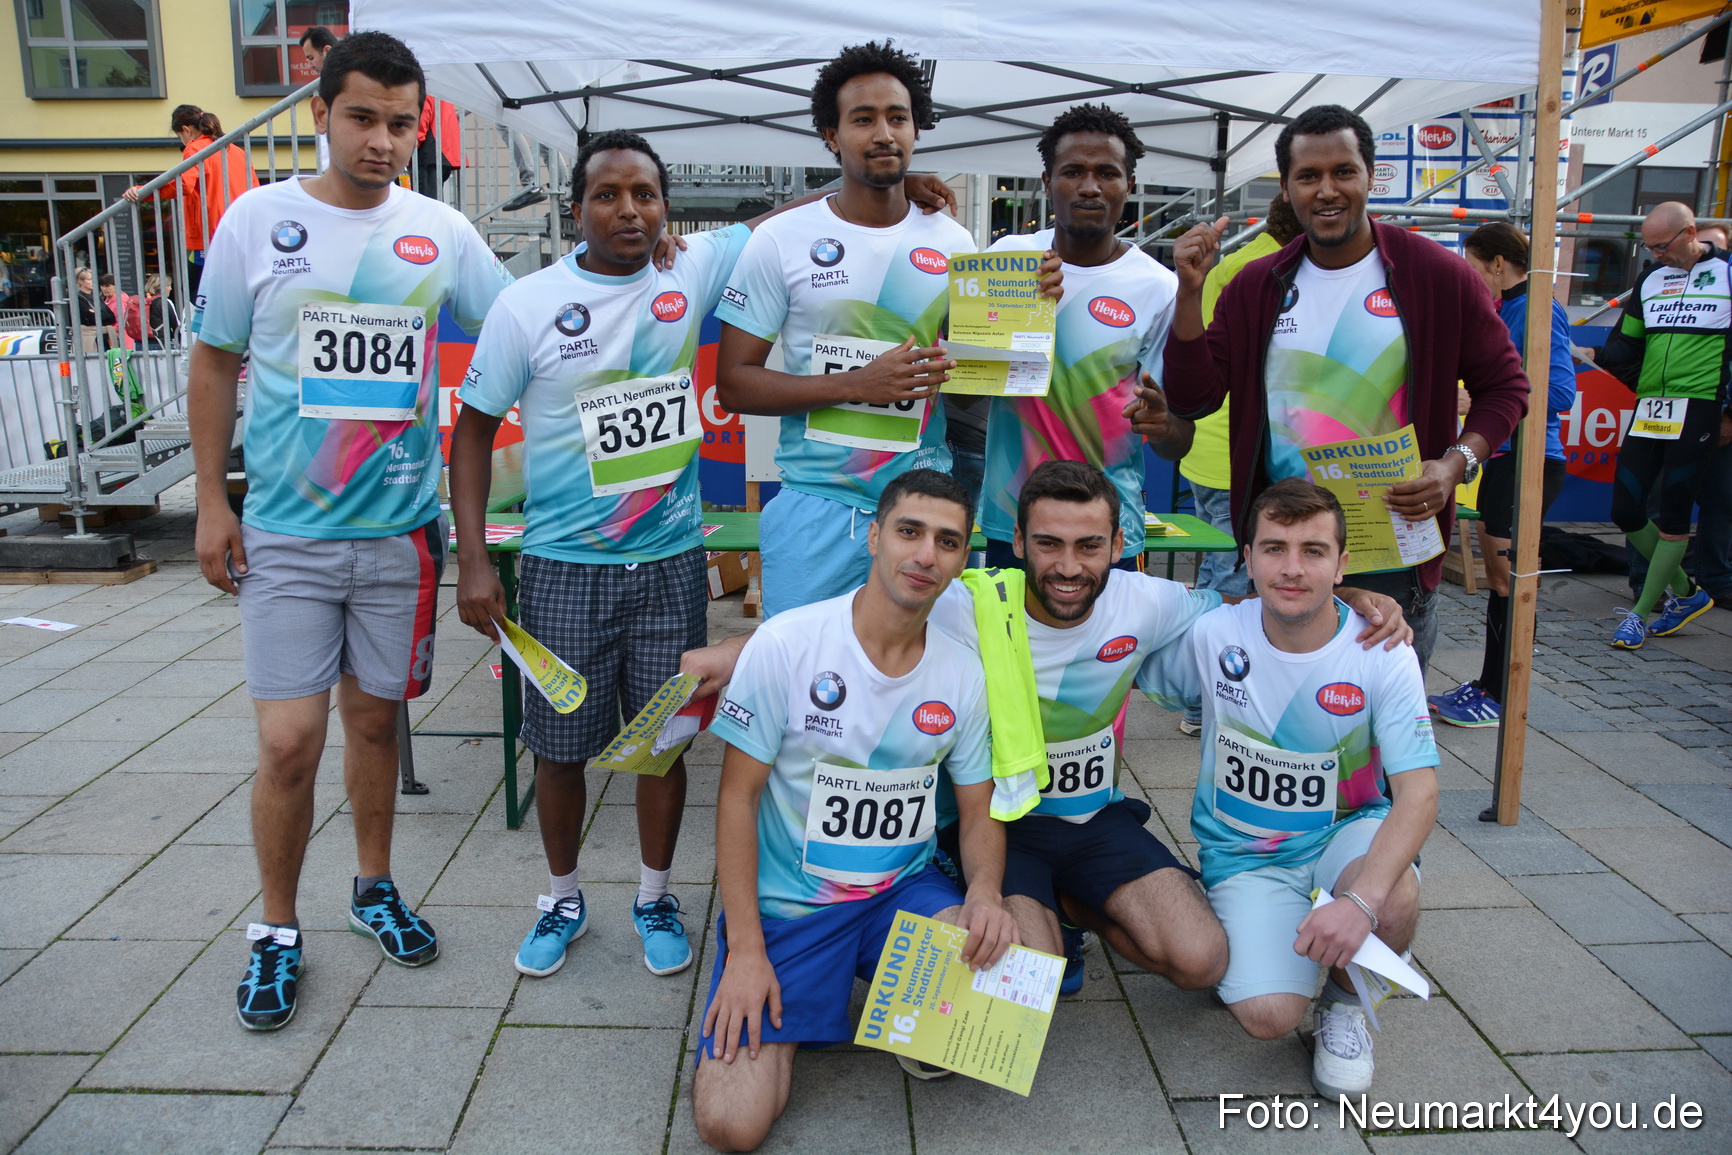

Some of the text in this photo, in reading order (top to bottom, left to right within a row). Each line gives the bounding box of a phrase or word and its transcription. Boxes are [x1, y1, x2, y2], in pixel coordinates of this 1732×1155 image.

[1420, 129, 1453, 144] Hervis
[1571, 126, 1648, 138] Unterer Markt 15
[399, 241, 434, 257] Hervis
[273, 258, 311, 269] PARTL
[914, 252, 946, 268] Hervis
[272, 266, 311, 276] Neumarkt
[811, 269, 849, 282] PARTL
[812, 278, 850, 289] Neumarkt
[954, 277, 1041, 297] 16. Neumarkt
[987, 288, 1038, 299] Stadtlauf
[656, 296, 685, 316] Hervis
[1094, 300, 1130, 322] Hervis
[1650, 301, 1718, 313] Laufteam
[303, 311, 408, 328] PARTL Neumarkt
[1656, 313, 1697, 324] Fürth
[313, 329, 417, 376] 3084
[559, 338, 598, 354] PARTL
[560, 348, 599, 361] Neumarkt
[815, 344, 853, 359] PARTL
[581, 382, 676, 413] PARTL Neumarkt
[1646, 400, 1673, 419] 121
[596, 395, 687, 453] 5327
[1643, 422, 1672, 432] Bernhard
[388, 440, 410, 461] 16.
[1307, 433, 1412, 461] URKUNDE
[1314, 453, 1415, 480] 16. Neumarkter
[1352, 467, 1405, 478] Stadtlauf
[1215, 690, 1248, 708] Neumarkt
[1216, 680, 1248, 701] PARTL
[1324, 689, 1362, 707] Hervis
[599, 674, 681, 761] URKUNDE
[610, 741, 644, 762] 16.
[639, 679, 687, 737] Neumarkter
[805, 714, 843, 730] PARTL
[918, 710, 950, 726] Hervis
[804, 724, 843, 738] Neumarkt
[1218, 735, 1316, 771] PARTL Neumarkt
[816, 773, 920, 793] PARTL Neumarkt
[1225, 755, 1326, 807] 3089
[822, 795, 926, 840] 3087
[864, 919, 918, 1041] URKUNDE
[912, 943, 942, 1008] Stadtlauf
[932, 966, 948, 1001] September
[944, 951, 953, 965] 2015
[886, 926, 934, 1044] 16. Neumarkter
